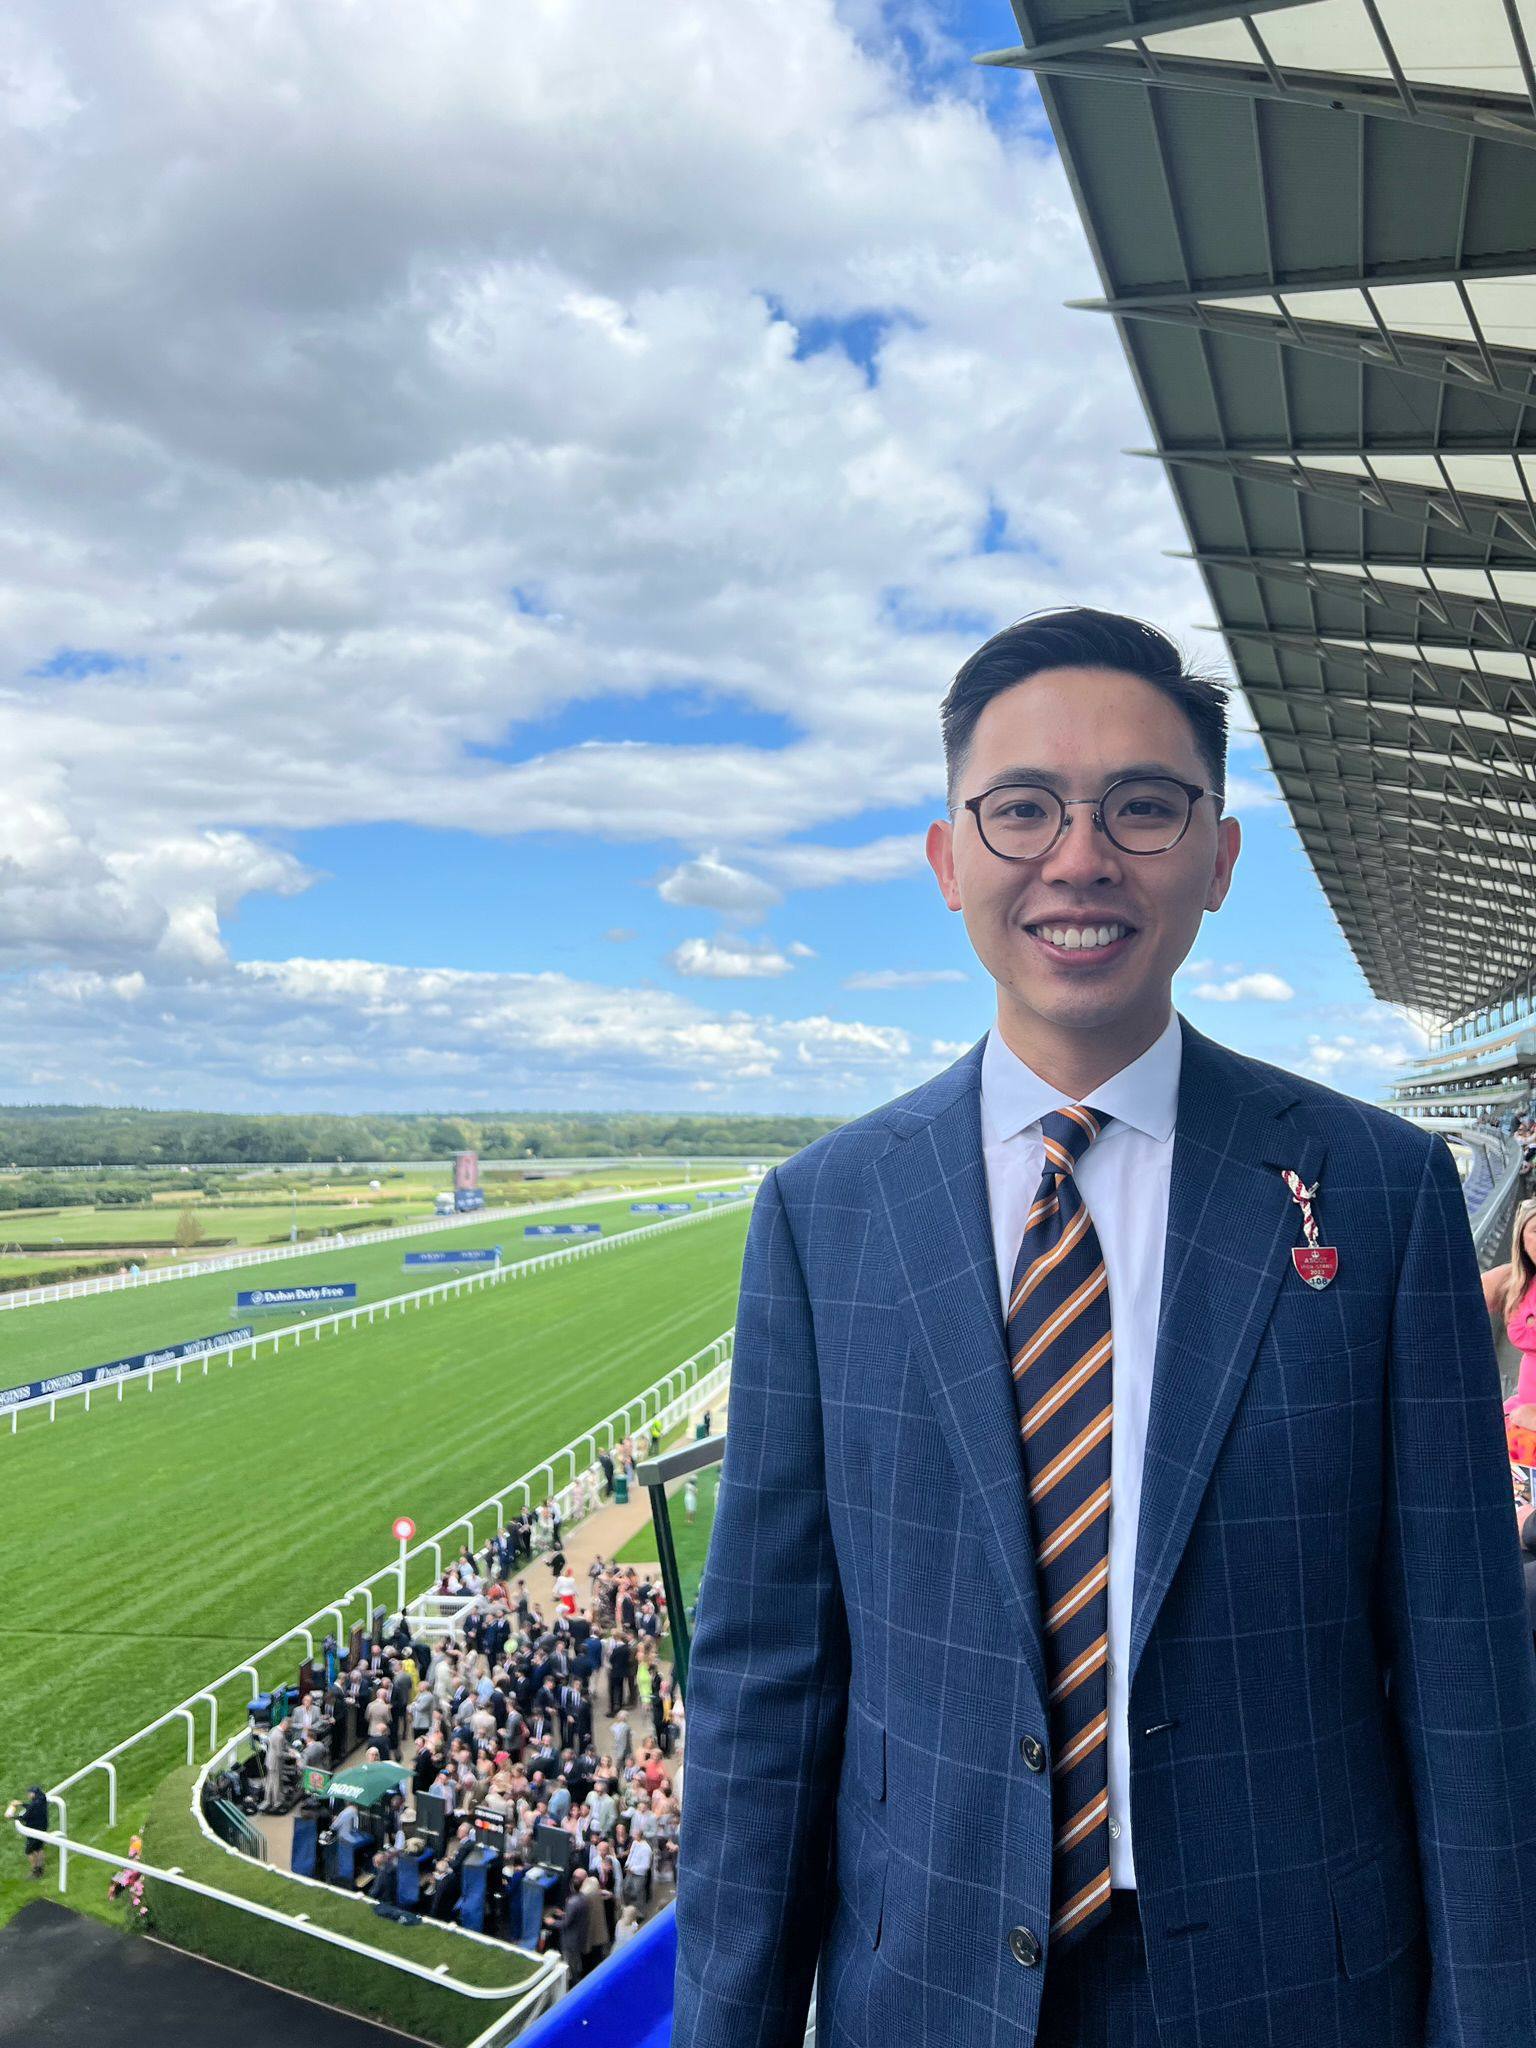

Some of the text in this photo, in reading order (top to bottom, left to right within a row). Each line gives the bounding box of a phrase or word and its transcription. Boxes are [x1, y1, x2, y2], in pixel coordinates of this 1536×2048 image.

[264, 1286, 344, 1302] Dubai Duty Free
[41, 1372, 83, 1393] LONGINES
